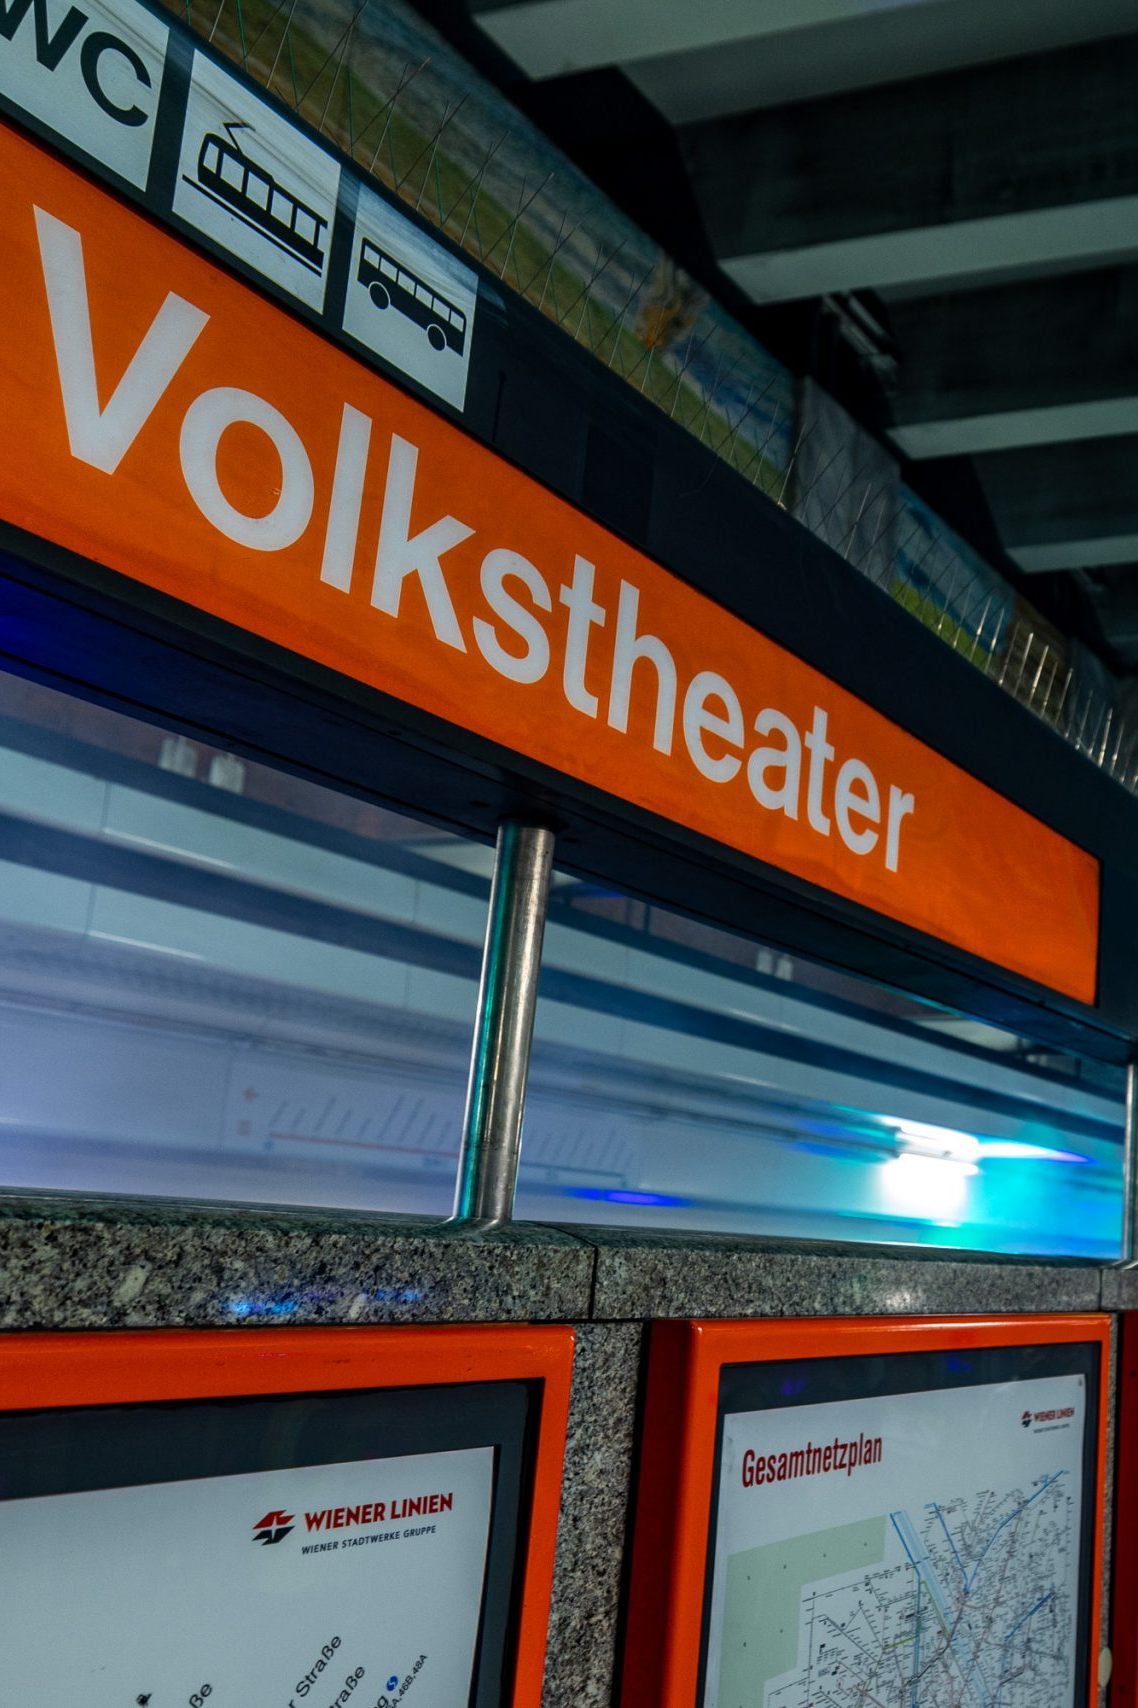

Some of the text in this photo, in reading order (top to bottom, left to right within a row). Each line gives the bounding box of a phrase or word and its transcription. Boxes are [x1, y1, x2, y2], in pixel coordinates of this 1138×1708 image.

[33, 204, 915, 872] Volkstheater
[742, 1433, 882, 1488] Gesamtnetzplan
[302, 1525, 436, 1555] WIENER STADTWERKE GRUPPE
[305, 1493, 453, 1532] WIENER LINIEN
[296, 1636, 341, 1698] Straße
